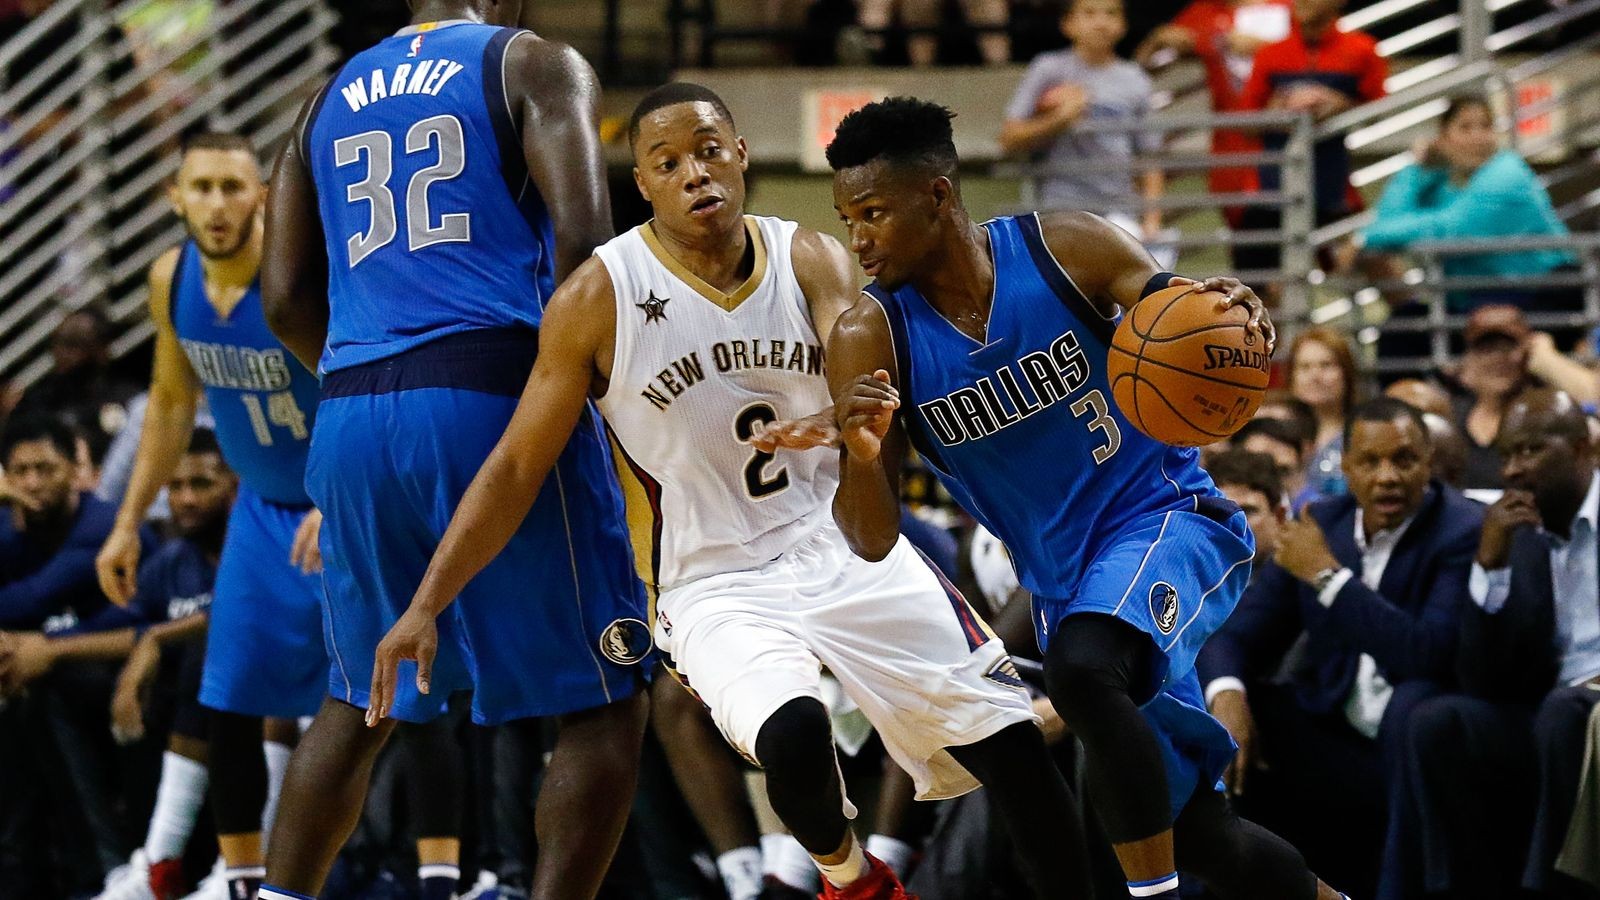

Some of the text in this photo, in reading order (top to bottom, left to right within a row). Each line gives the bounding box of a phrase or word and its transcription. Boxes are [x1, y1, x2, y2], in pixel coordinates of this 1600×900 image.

[341, 58, 464, 113] WARNEY
[334, 114, 471, 269] 32
[180, 337, 292, 392] ALLAS
[640, 337, 827, 413] NEW ORLEAN
[918, 329, 1090, 447] DALLAS
[1203, 344, 1270, 374] SPALDI
[240, 391, 308, 446] 14
[1069, 388, 1122, 465] 3
